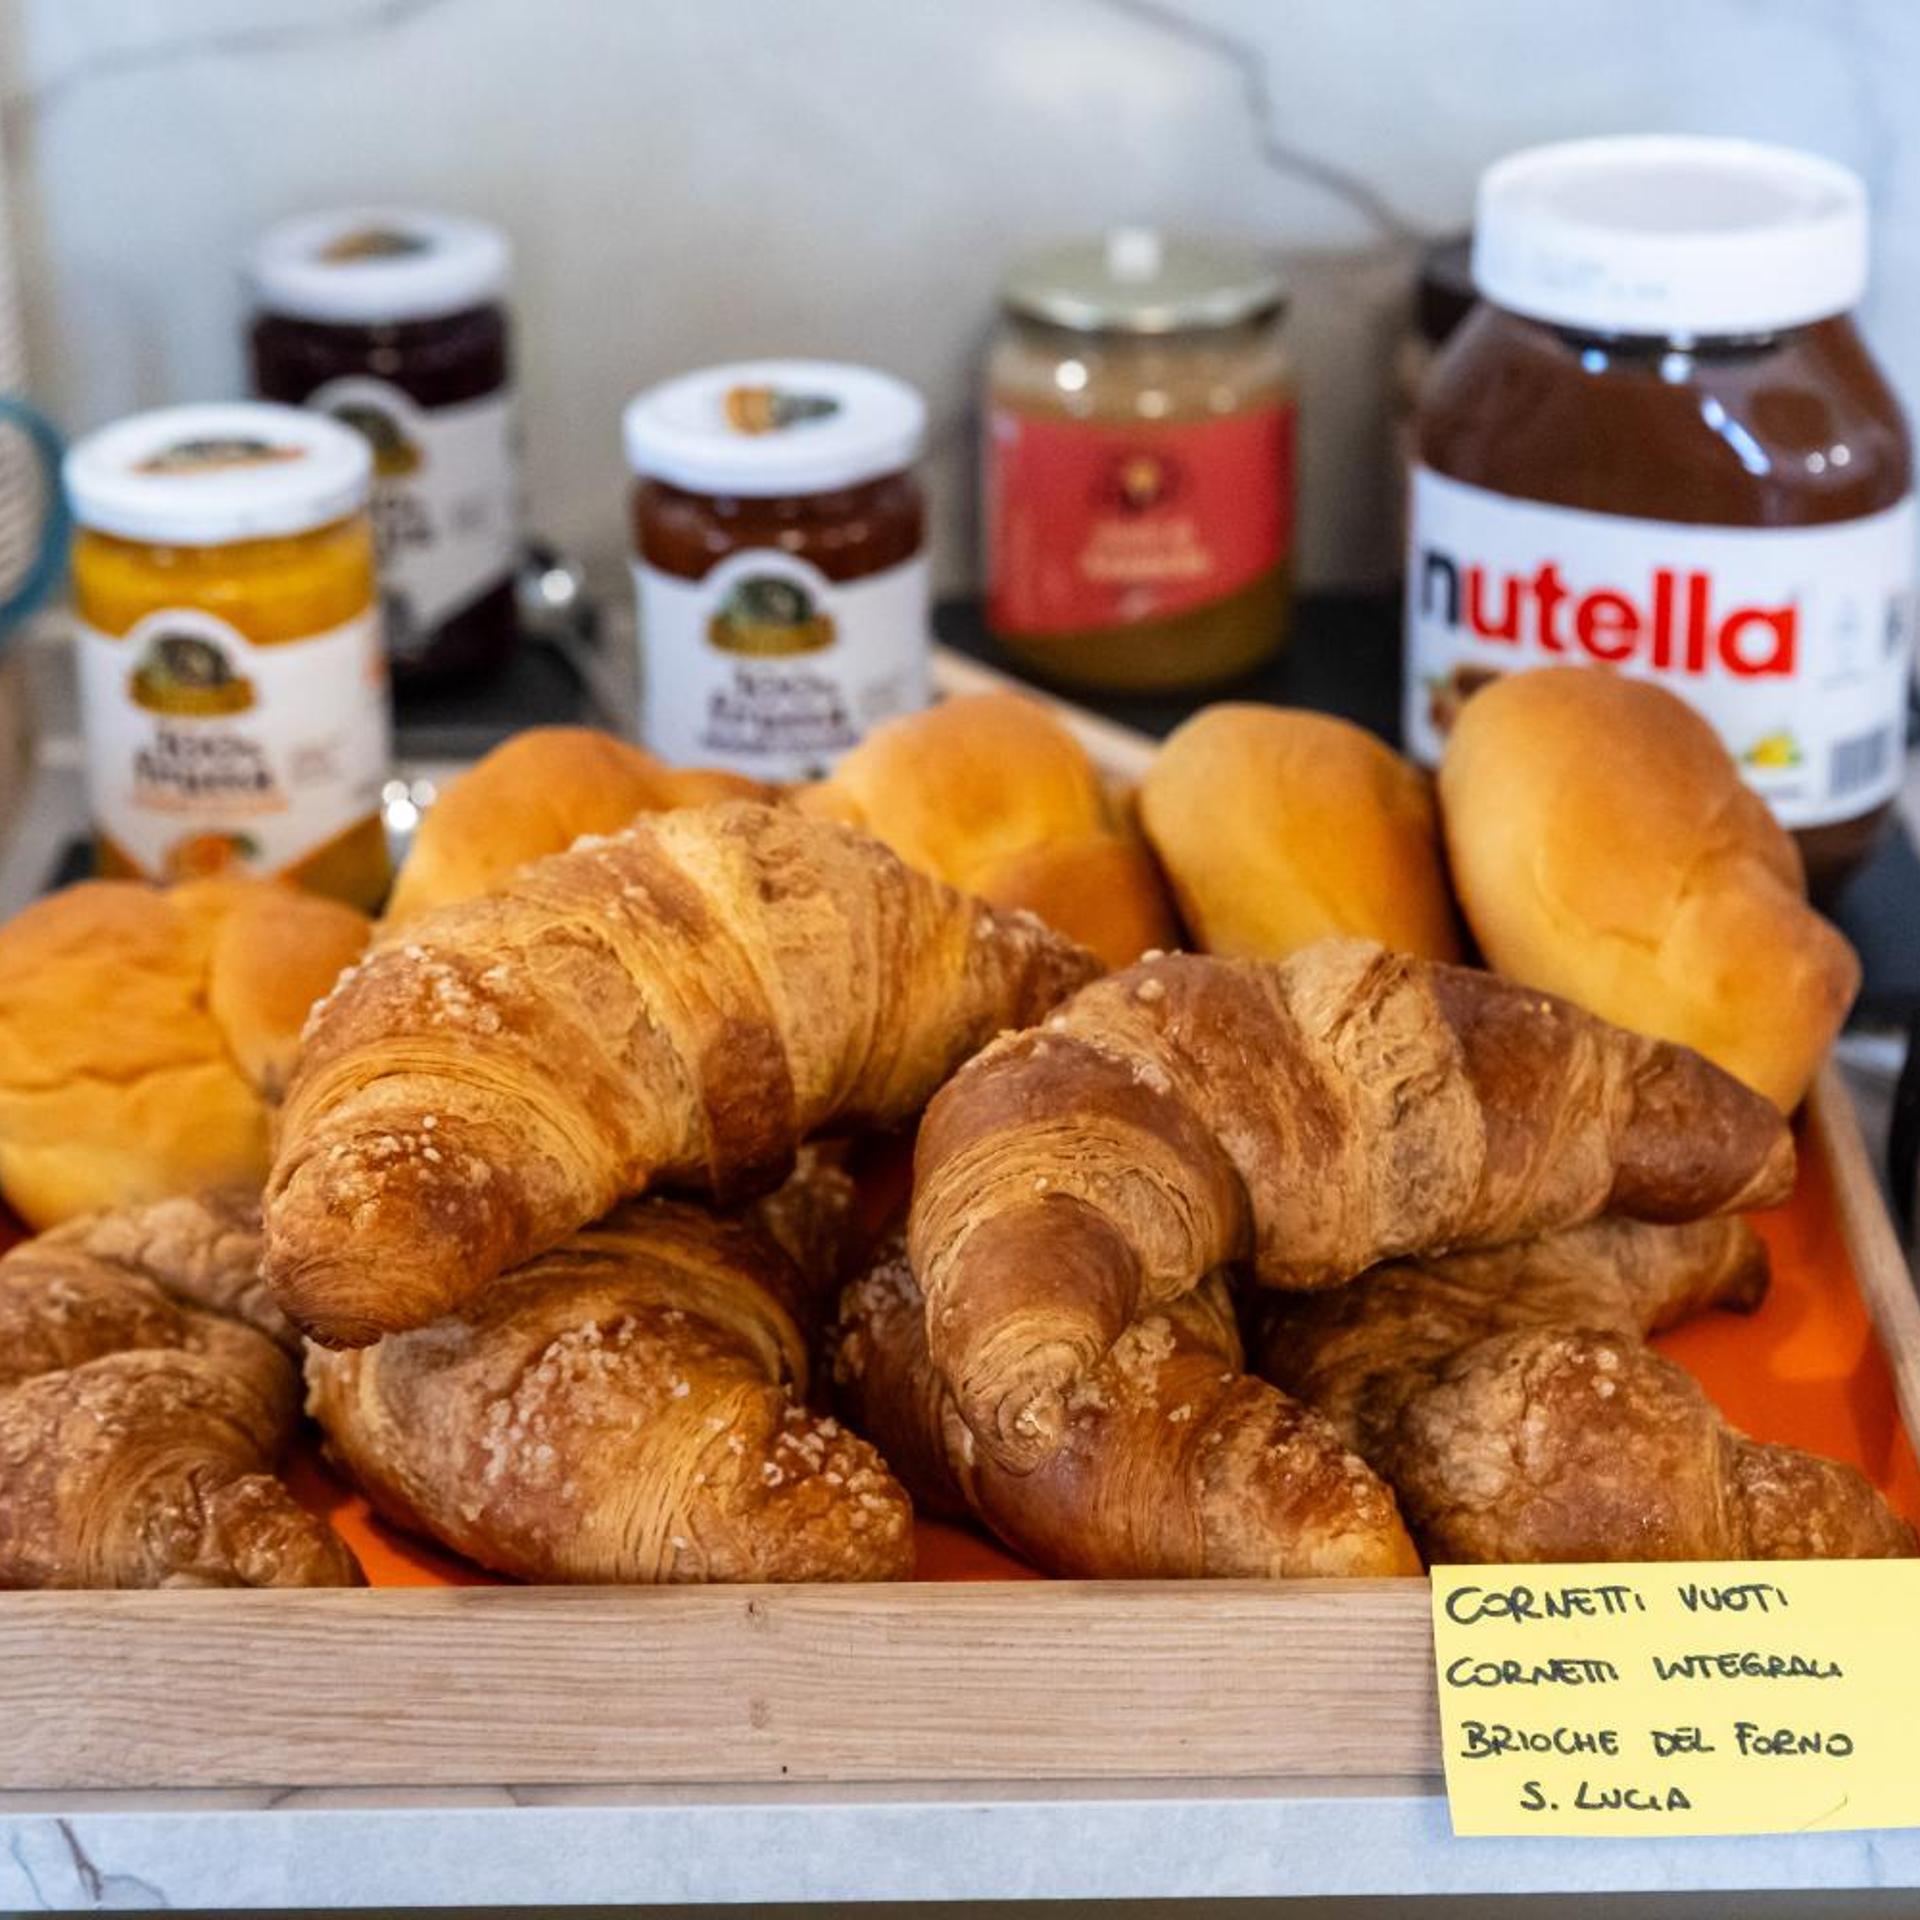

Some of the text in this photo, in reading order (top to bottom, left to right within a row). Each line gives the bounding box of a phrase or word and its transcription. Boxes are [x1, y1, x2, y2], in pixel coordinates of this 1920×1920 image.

[1424, 550, 1797, 678] nutella
[1445, 1583, 1788, 1625] CORNETTI VUOTI
[1446, 1657, 1619, 1688] CORNETTI
[1461, 1721, 1853, 1759] BRIOCHE DEL FORNO
[1520, 1781, 1691, 1811] S. LUCIA
